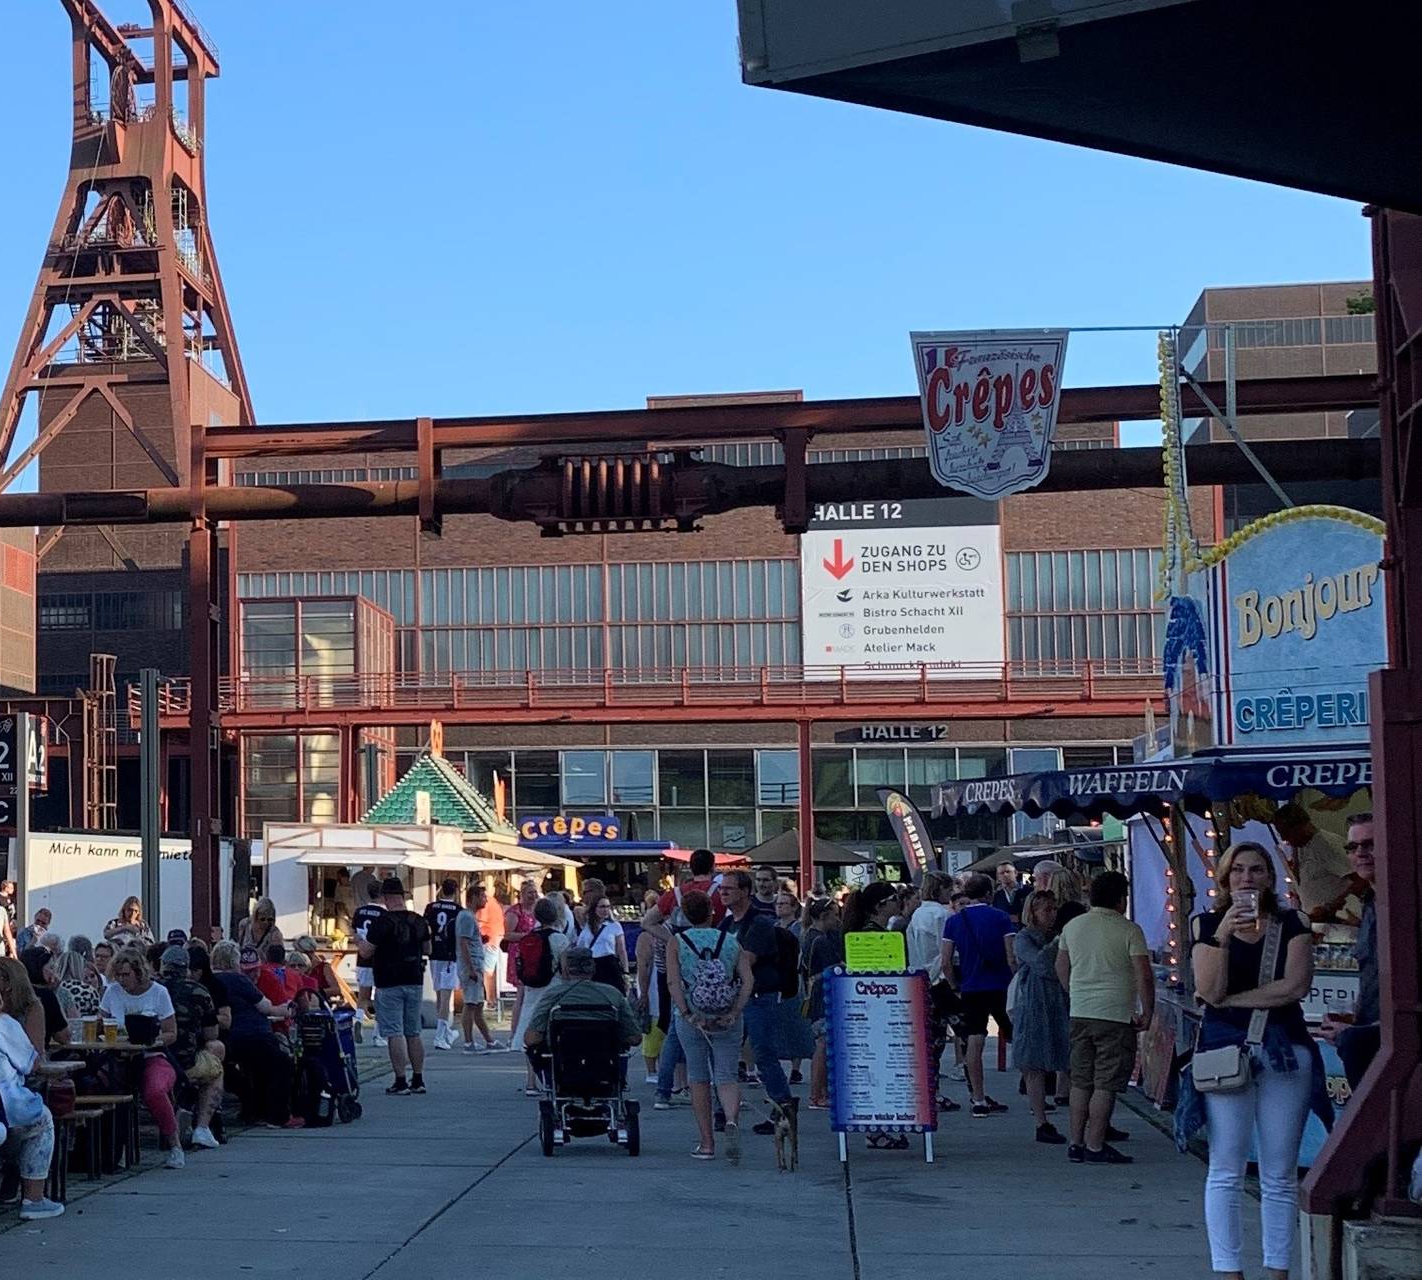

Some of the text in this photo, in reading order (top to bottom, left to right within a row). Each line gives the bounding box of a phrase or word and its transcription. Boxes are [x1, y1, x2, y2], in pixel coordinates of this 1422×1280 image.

[927, 364, 1055, 434] Crêpes
[812, 503, 902, 521] HALLE 12
[861, 544, 946, 558] ZUGANG ZU
[862, 559, 947, 573] DEN SHOPS
[862, 588, 985, 600] Arka Kulturwerkstatt
[863, 608, 897, 618] Bistro
[900, 607, 945, 617] Schacht
[1234, 562, 1379, 650] Bonjour
[863, 625, 945, 636] Grubenhelden
[864, 643, 936, 653] Atelier Mack
[862, 725, 948, 739] HALLE 12
[2, 773, 13, 781] XII
[1067, 770, 1190, 796] WAFFELN
[965, 780, 1016, 802] CREPES
[49, 843, 82, 855] Mich
[87, 844, 120, 857] kann
[437, 911, 447, 933] 9
